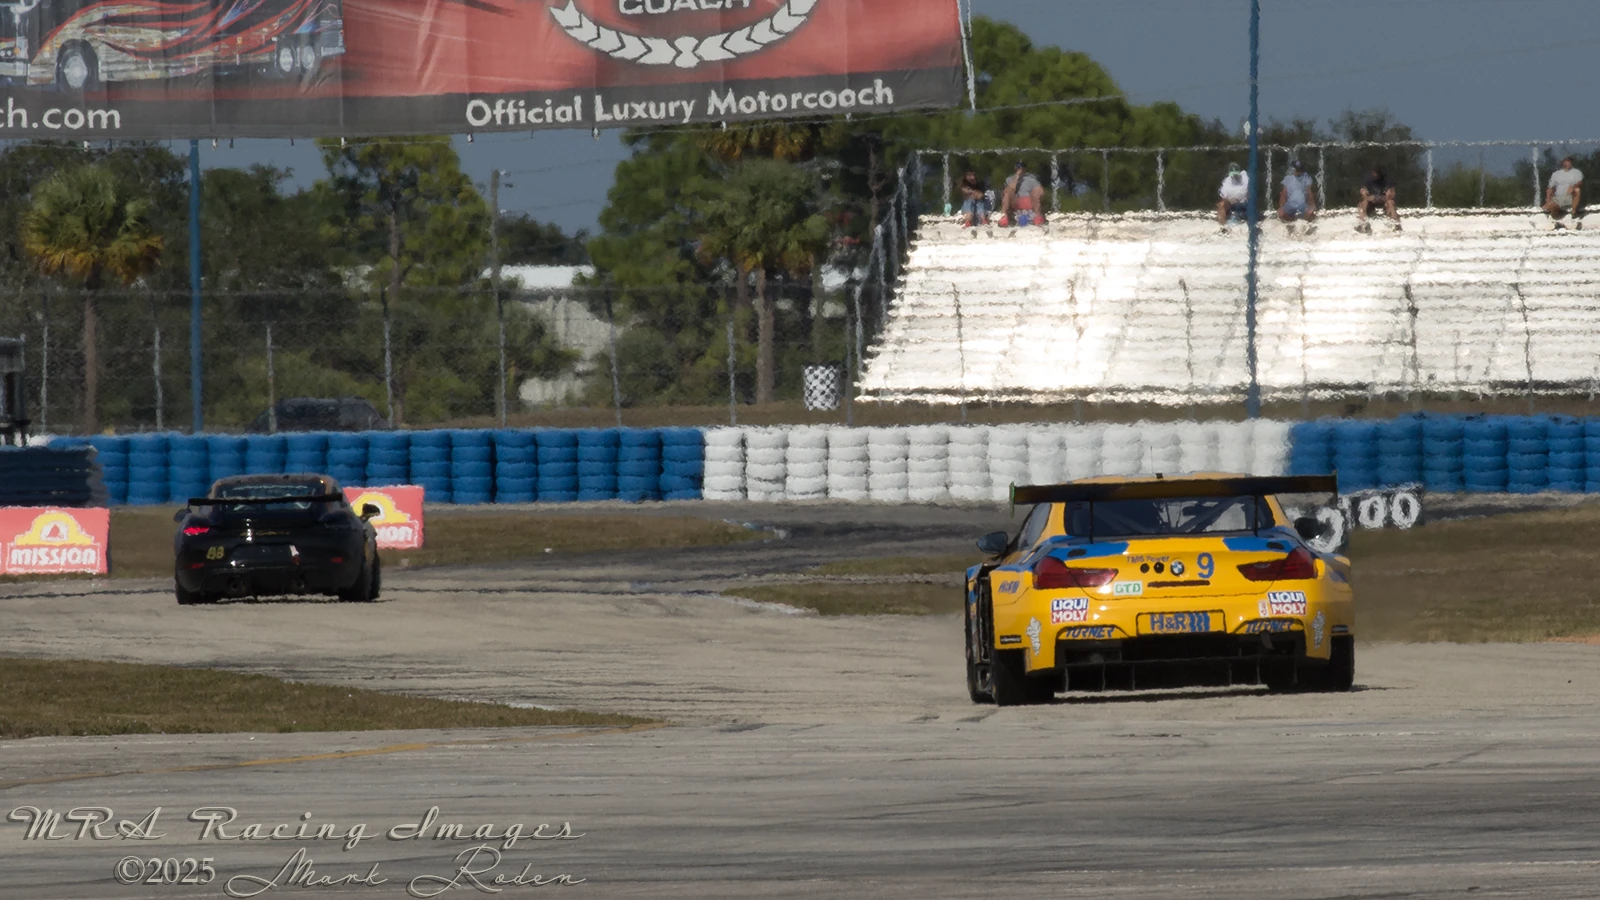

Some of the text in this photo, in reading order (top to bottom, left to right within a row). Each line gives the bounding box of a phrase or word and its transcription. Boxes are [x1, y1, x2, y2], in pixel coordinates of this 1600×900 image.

[465, 79, 895, 127] Official Luxury Motorcoach
[0, 97, 120, 129] h.com
[1196, 552, 1215, 579] 9
[1115, 583, 1141, 593] GTD
[1269, 592, 1305, 603] LIQUI
[1052, 599, 1088, 611] LIQUI
[1271, 602, 1306, 615] MOLY
[1052, 610, 1087, 623] MOLY
